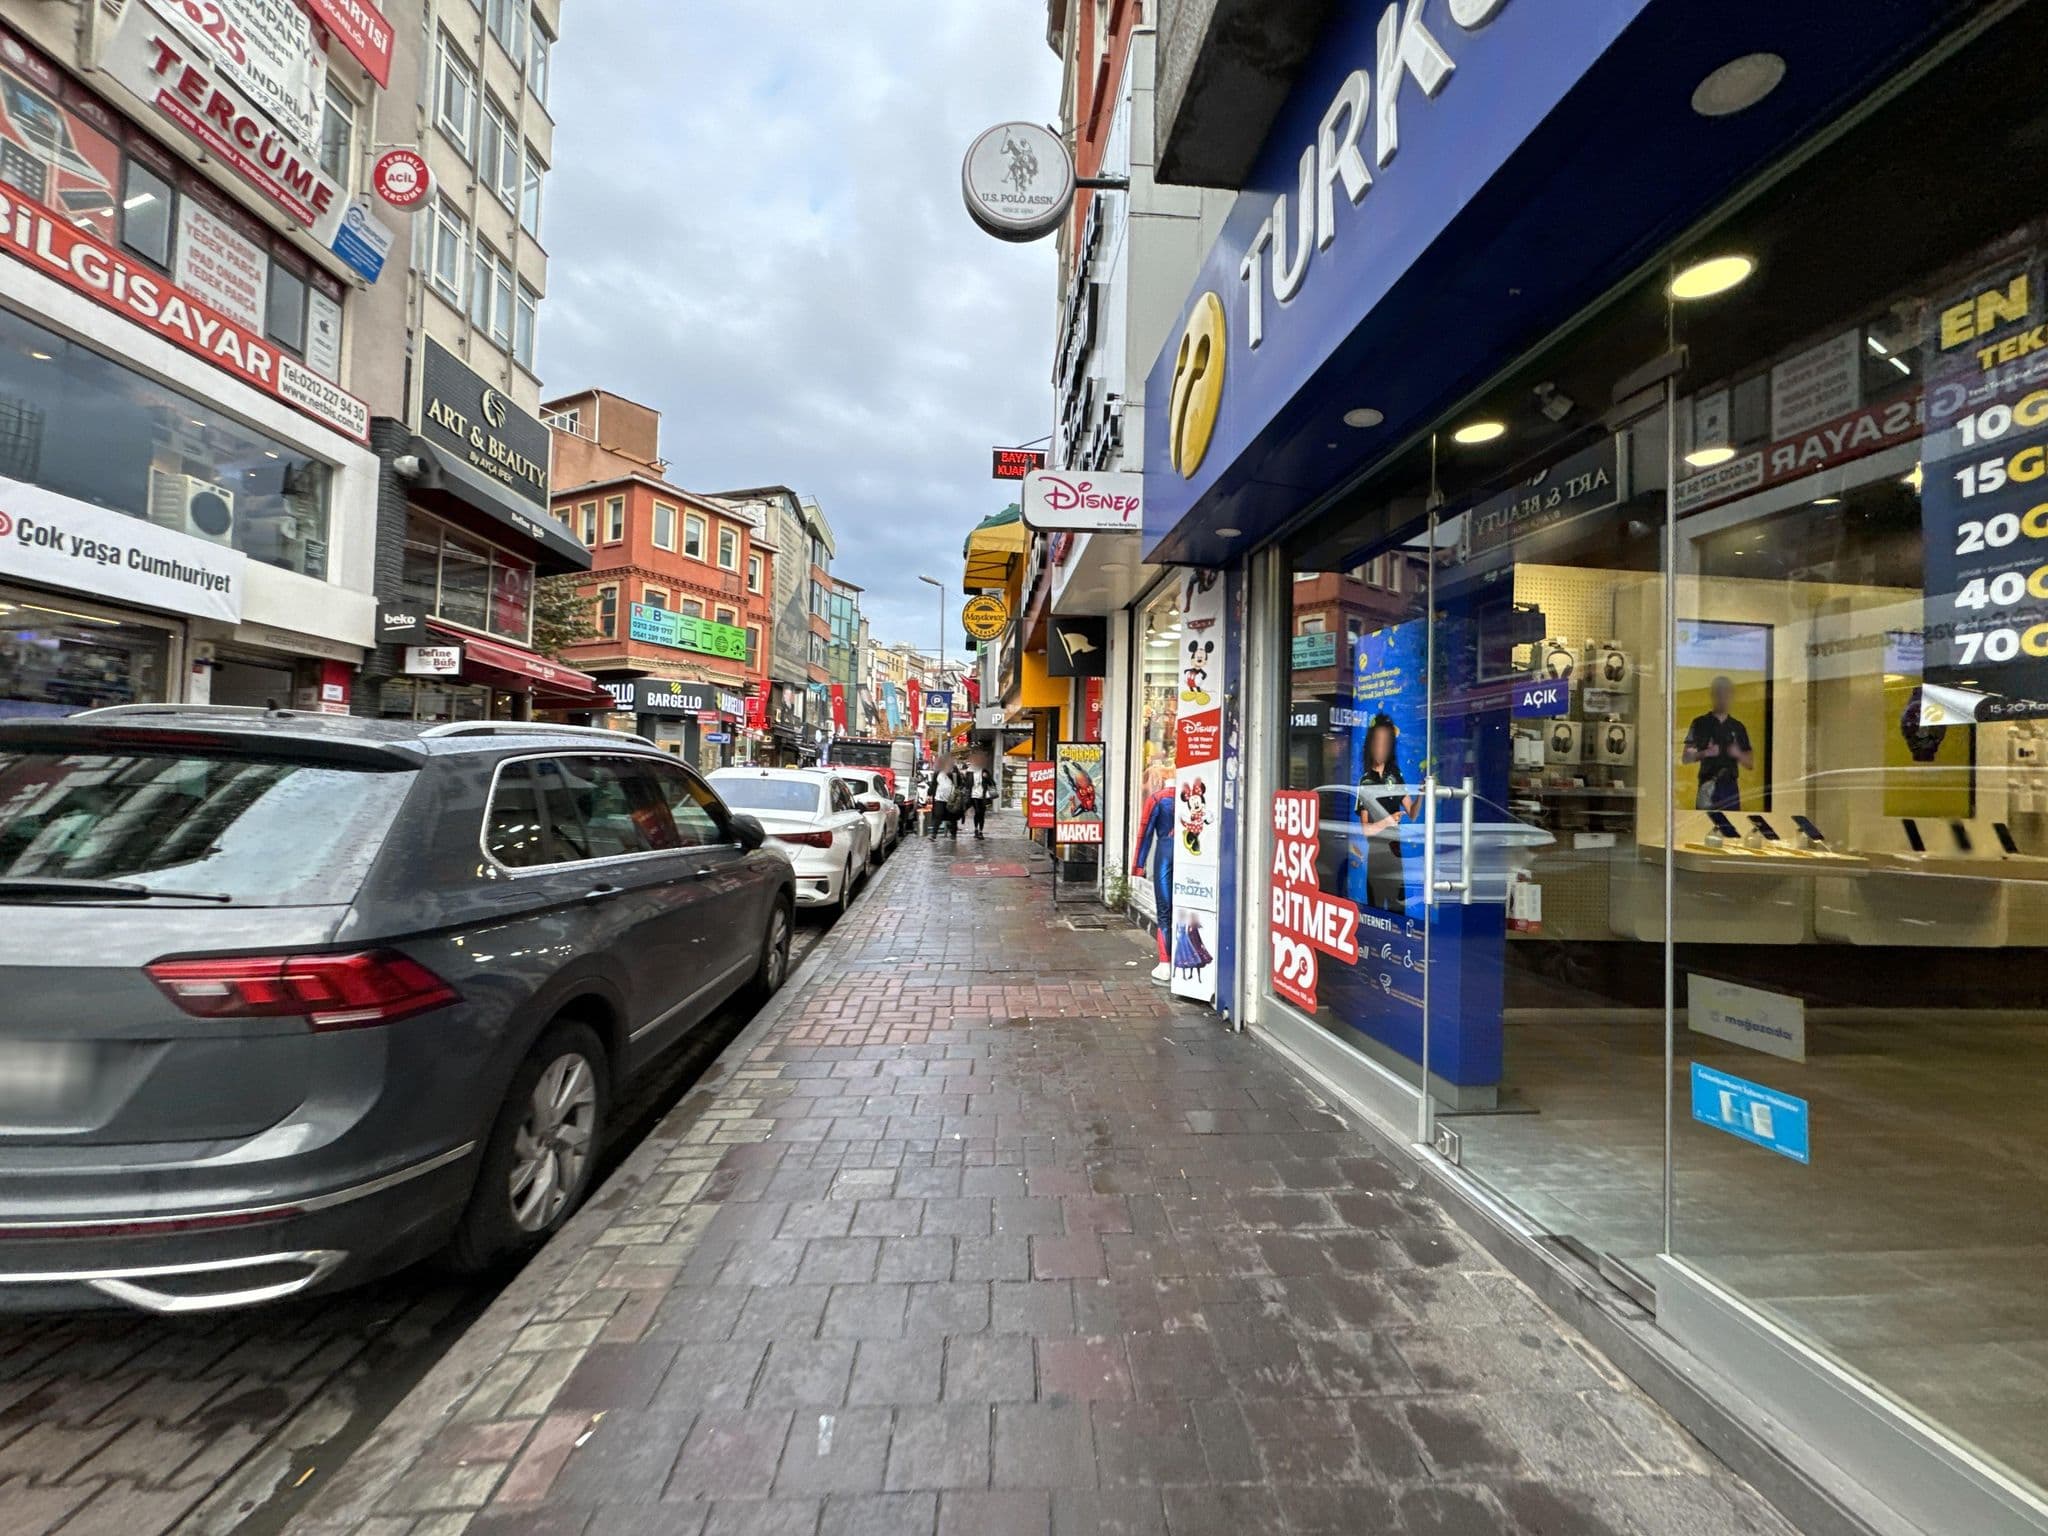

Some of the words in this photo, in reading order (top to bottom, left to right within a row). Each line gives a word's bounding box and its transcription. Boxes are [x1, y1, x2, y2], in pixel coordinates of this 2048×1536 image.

[153, 36, 334, 215] TERCÜME
[388, 172, 415, 183] ACİL
[1240, 0, 1506, 351] TURK
[1001, 193, 1026, 204] POLO
[1941, 273, 2029, 352] EN
[323, 386, 339, 407] 227
[340, 397, 352, 416] 94
[354, 405, 365, 422] 30
[427, 398, 468, 438] ART
[470, 425, 486, 452] &
[487, 434, 546, 488] BEAUTY
[17, 517, 65, 552] Çok
[71, 535, 121, 565] yaşa
[127, 547, 231, 593] Cumhuriyet
[384, 613, 417, 625] beko
[634, 605, 662, 622] RGB
[418, 648, 452, 658] Define
[647, 692, 702, 710] BARGELLO
[1523, 688, 1558, 709] AÇIK
[1057, 823, 1102, 842] MARVEL
[1274, 798, 1317, 840] #BU
[1273, 838, 1316, 886] AŞK
[1174, 882, 1214, 899] FROZEN
[1271, 880, 1354, 956] BİTMEZ
